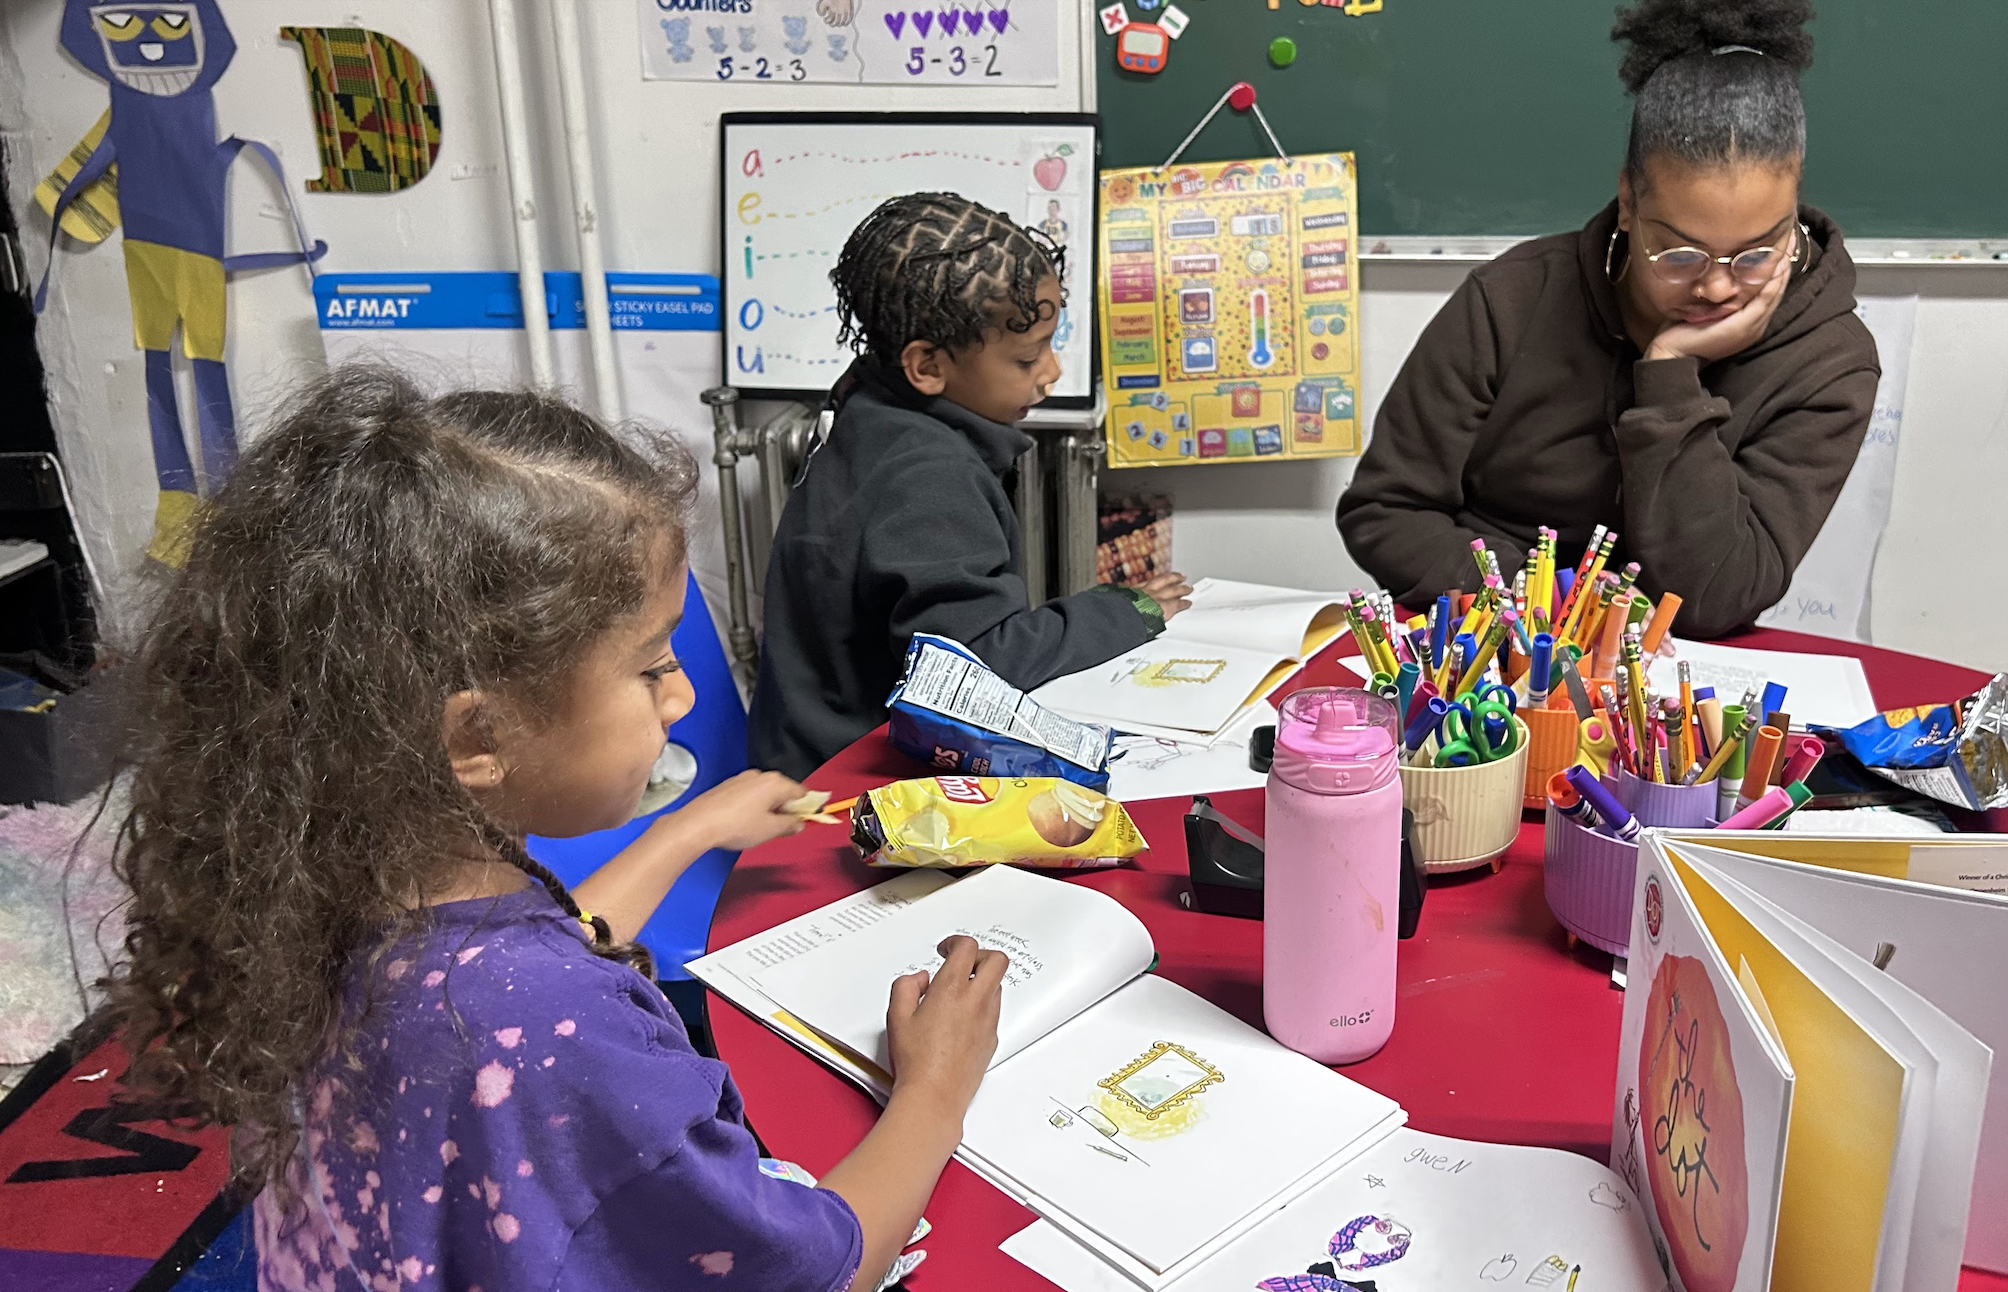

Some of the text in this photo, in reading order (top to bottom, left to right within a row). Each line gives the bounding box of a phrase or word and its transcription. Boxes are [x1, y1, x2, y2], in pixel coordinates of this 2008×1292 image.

[742, 150, 765, 178] a
[1139, 182, 1166, 199] MY
[1181, 179, 1206, 194] BIG
[737, 192, 761, 226] e
[744, 236, 754, 279] i
[326, 298, 411, 318] AFMAT
[614, 301, 653, 313] STICKY
[655, 302, 689, 314] EASEL
[690, 302, 714, 314] PAD
[739, 299, 764, 331] o
[737, 346, 765, 374] u
[932, 674, 951, 706] Nutrition
[946, 656, 959, 675] Facts
[956, 687, 972, 714] Calories
[1116, 815, 1126, 840] POTATO
[1329, 1015, 1357, 1027] ello
[1674, 1018, 1711, 1133] the
[1654, 1078, 1719, 1252] dot
